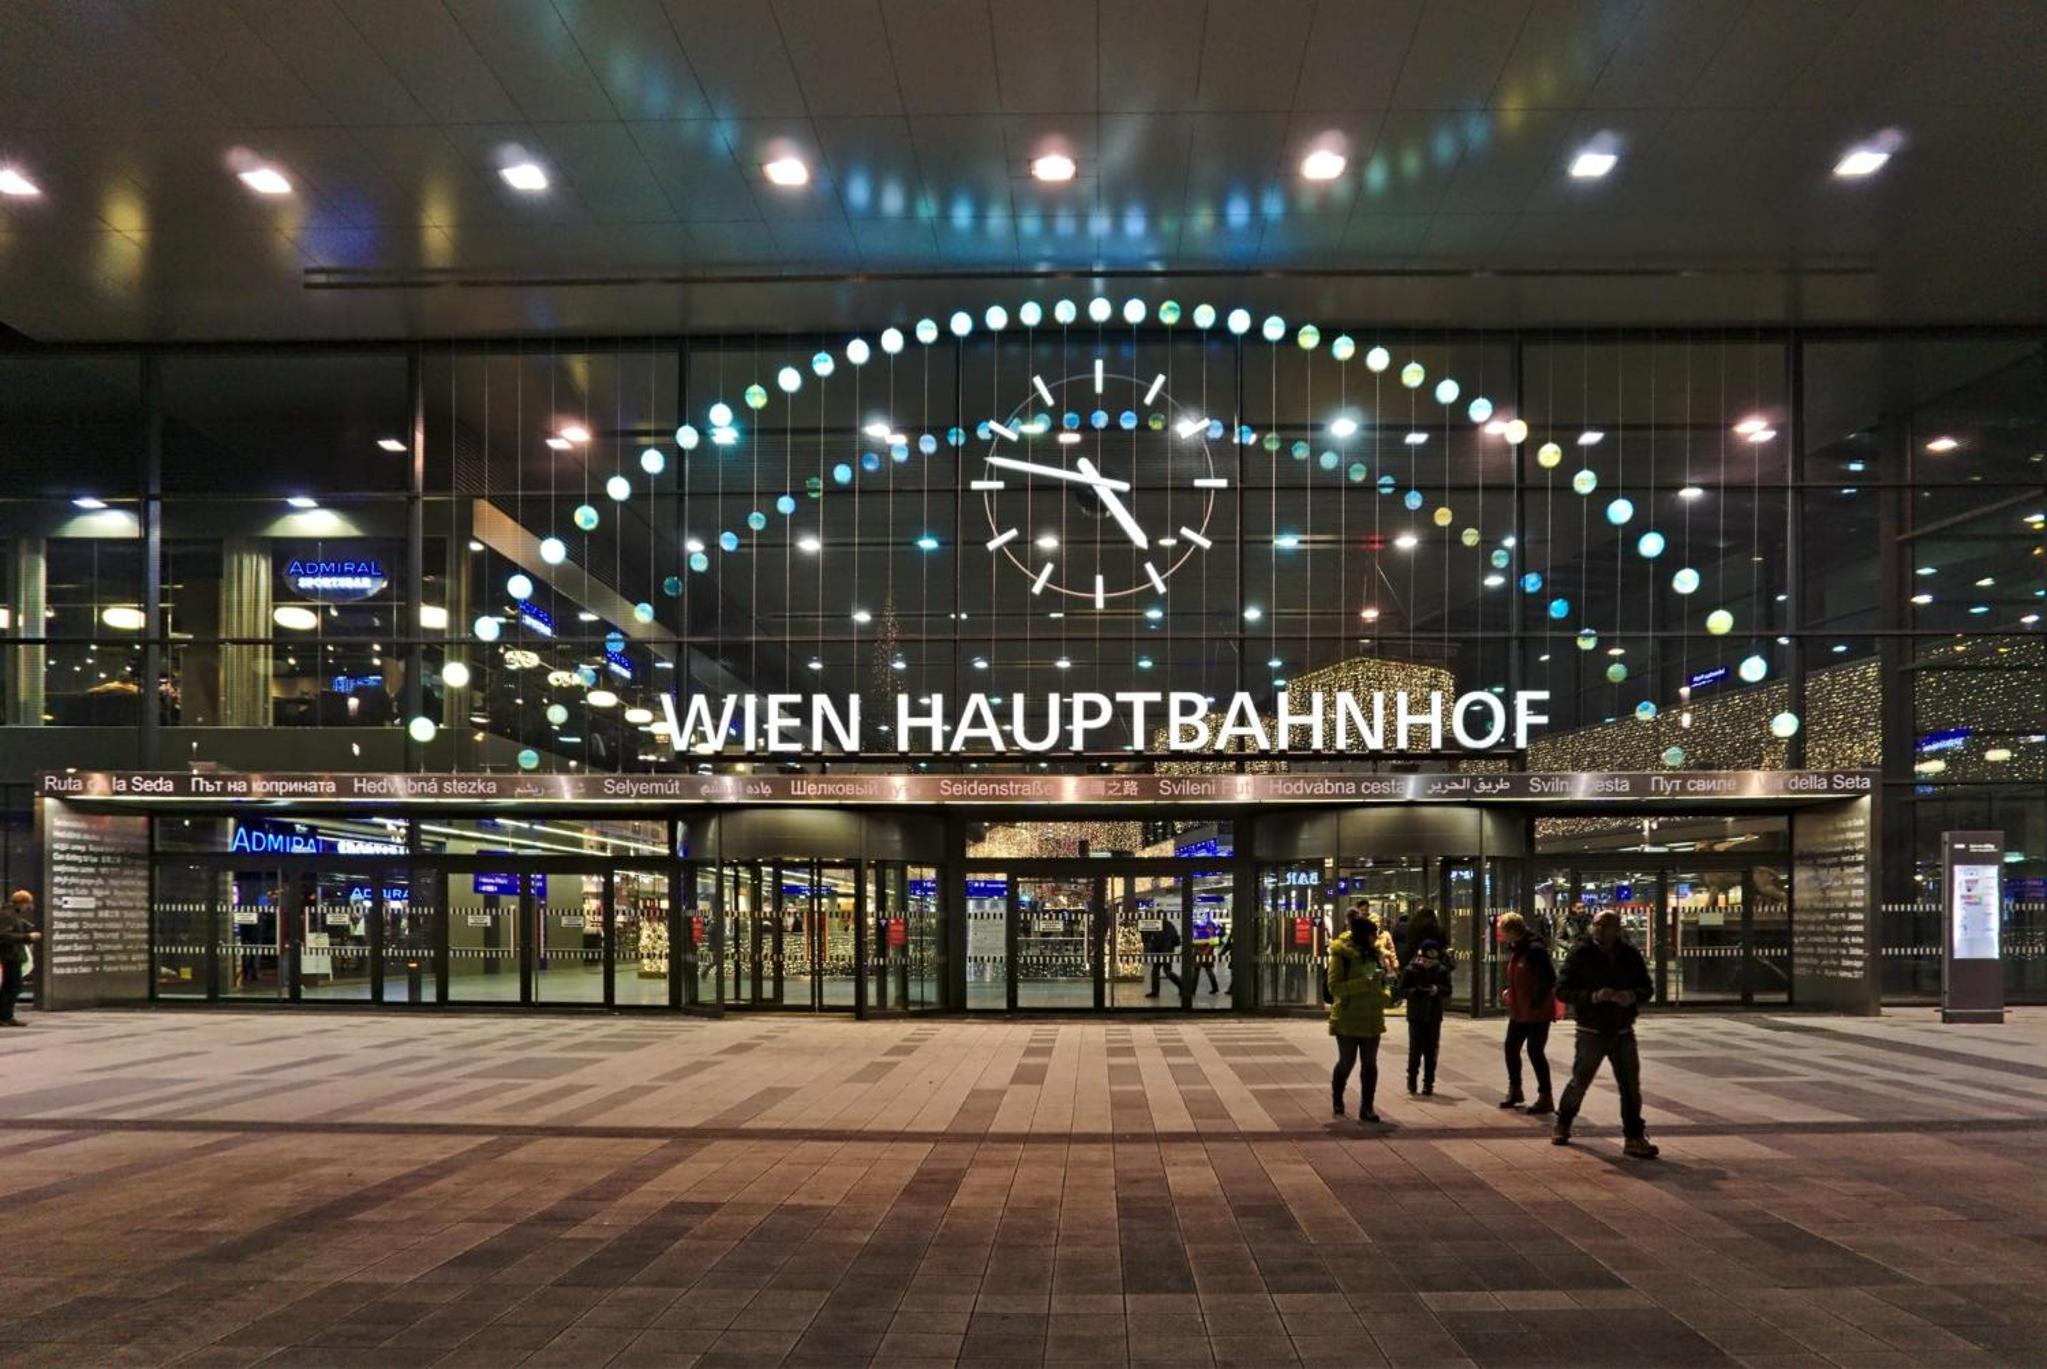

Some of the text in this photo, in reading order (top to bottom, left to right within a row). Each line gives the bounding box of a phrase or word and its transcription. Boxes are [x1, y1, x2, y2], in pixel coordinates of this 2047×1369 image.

[288, 561, 382, 576] ADMIRAL
[660, 691, 1551, 752] WIEN HAUPTBAHNHOF
[45, 776, 82, 791] Ruta
[112, 776, 127, 791] la
[131, 776, 174, 792] Seda
[190, 778, 336, 796] Път на коприната
[442, 779, 497, 794] stezka
[603, 778, 680, 797] Selyemút
[790, 779, 878, 796] Шелковый
[939, 778, 1055, 796] Seidenstraße
[1159, 779, 1216, 796] Svileni
[1361, 778, 1405, 794] cesta
[1528, 777, 1631, 793] Sviln esta
[1650, 776, 1737, 795] Пут свиле
[1788, 775, 1828, 790] della
[1832, 774, 1871, 790] Seta
